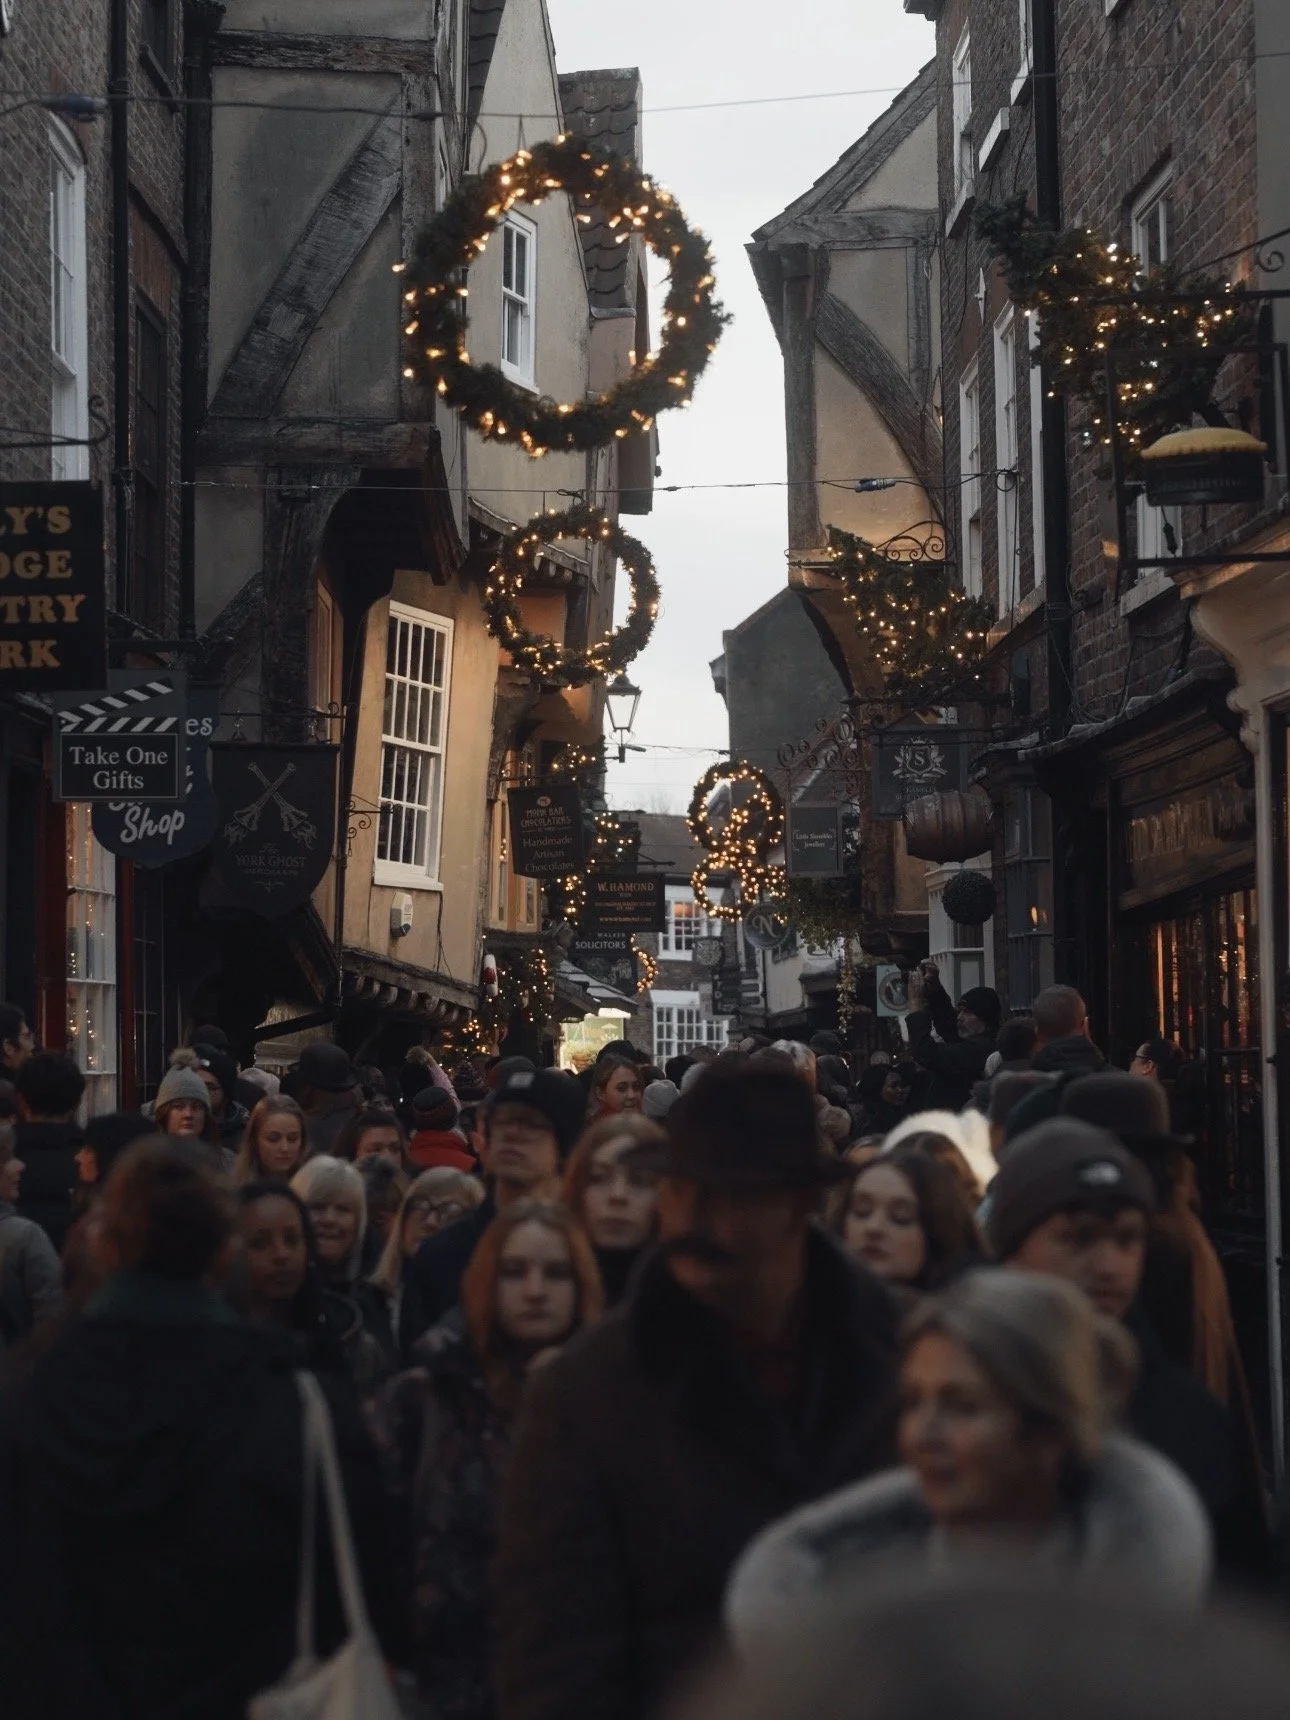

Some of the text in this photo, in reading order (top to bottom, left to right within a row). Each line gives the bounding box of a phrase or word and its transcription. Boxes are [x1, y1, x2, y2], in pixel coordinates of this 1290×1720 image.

[69, 746, 168, 765] Take One
[92, 770, 145, 790] Gifts
[119, 805, 186, 845] Shop
[522, 835, 573, 848] Handmade
[532, 849, 565, 860] Artisan
[235, 855, 307, 868] YORK GHOST
[524, 861, 576, 872] Chocolates
[575, 941, 627, 949] SOLICITORS
